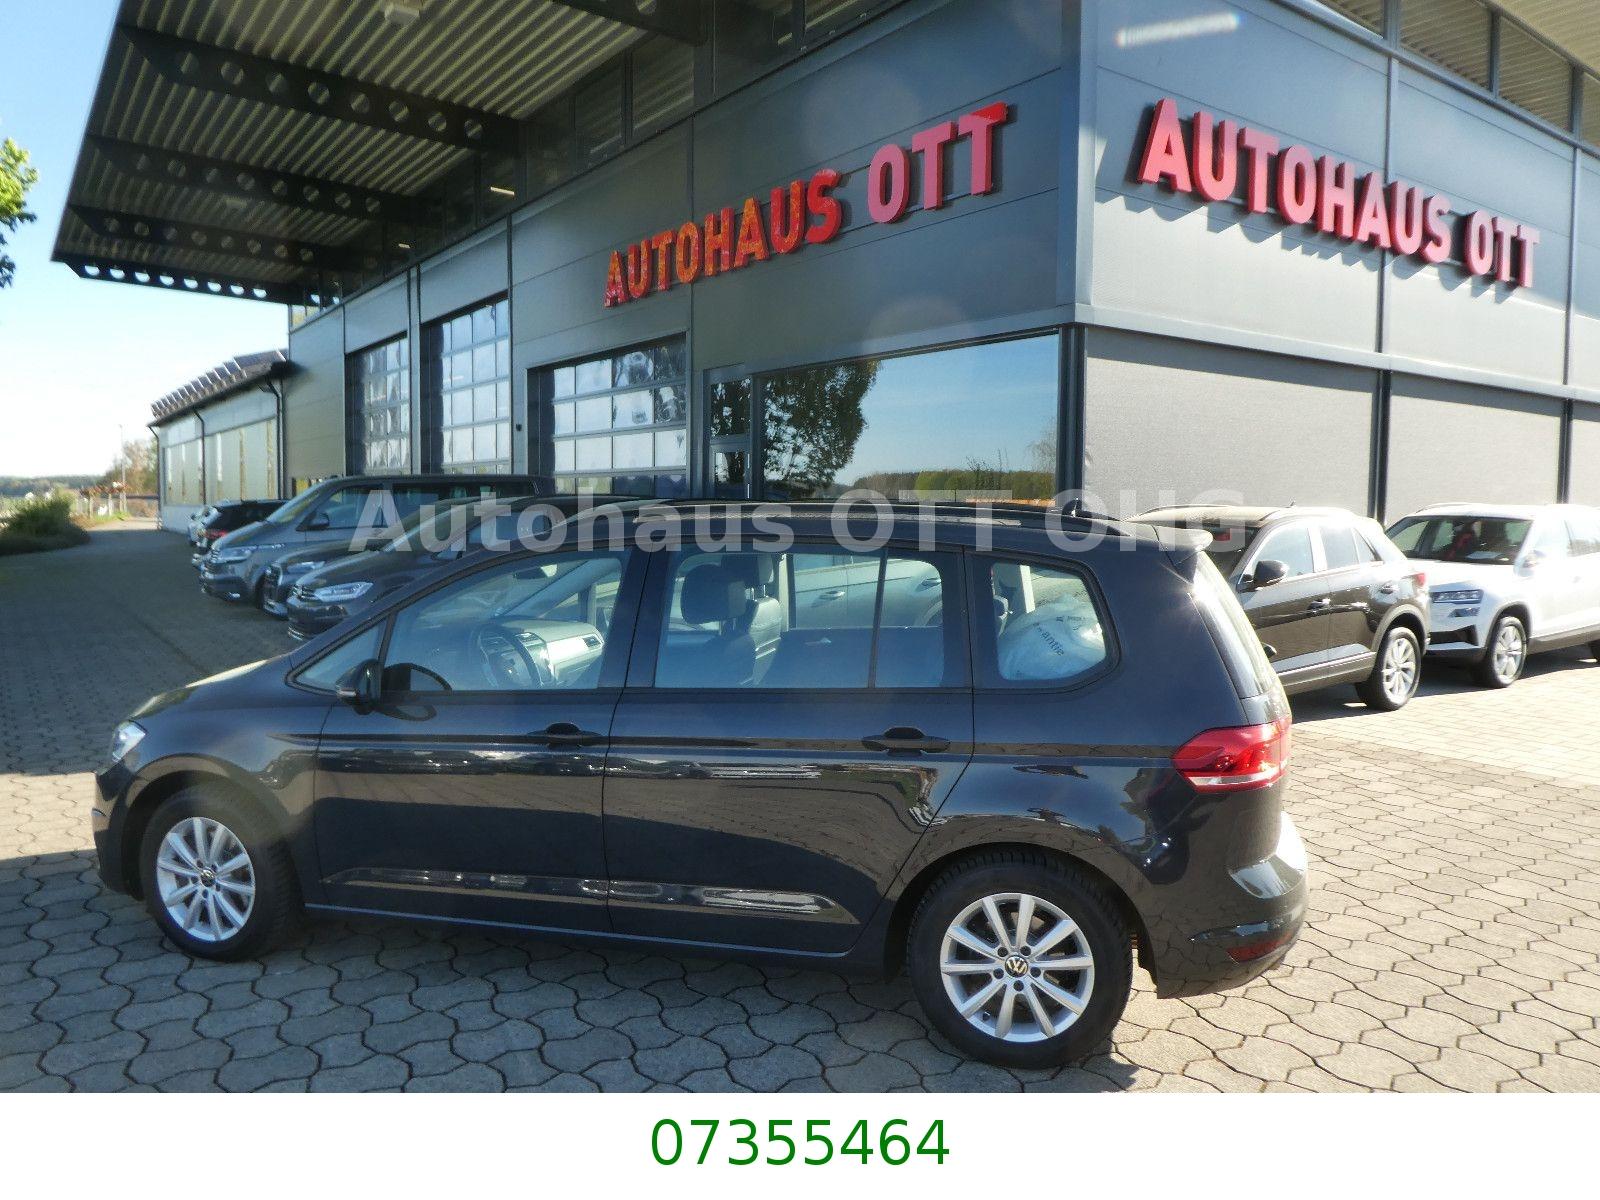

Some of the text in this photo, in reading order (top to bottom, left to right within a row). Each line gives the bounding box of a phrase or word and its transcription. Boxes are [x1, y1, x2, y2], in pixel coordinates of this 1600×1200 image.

[603, 102, 1009, 308] AUTOHAUS OTT
[1137, 97, 1541, 288] AUTOHAUS OTT
